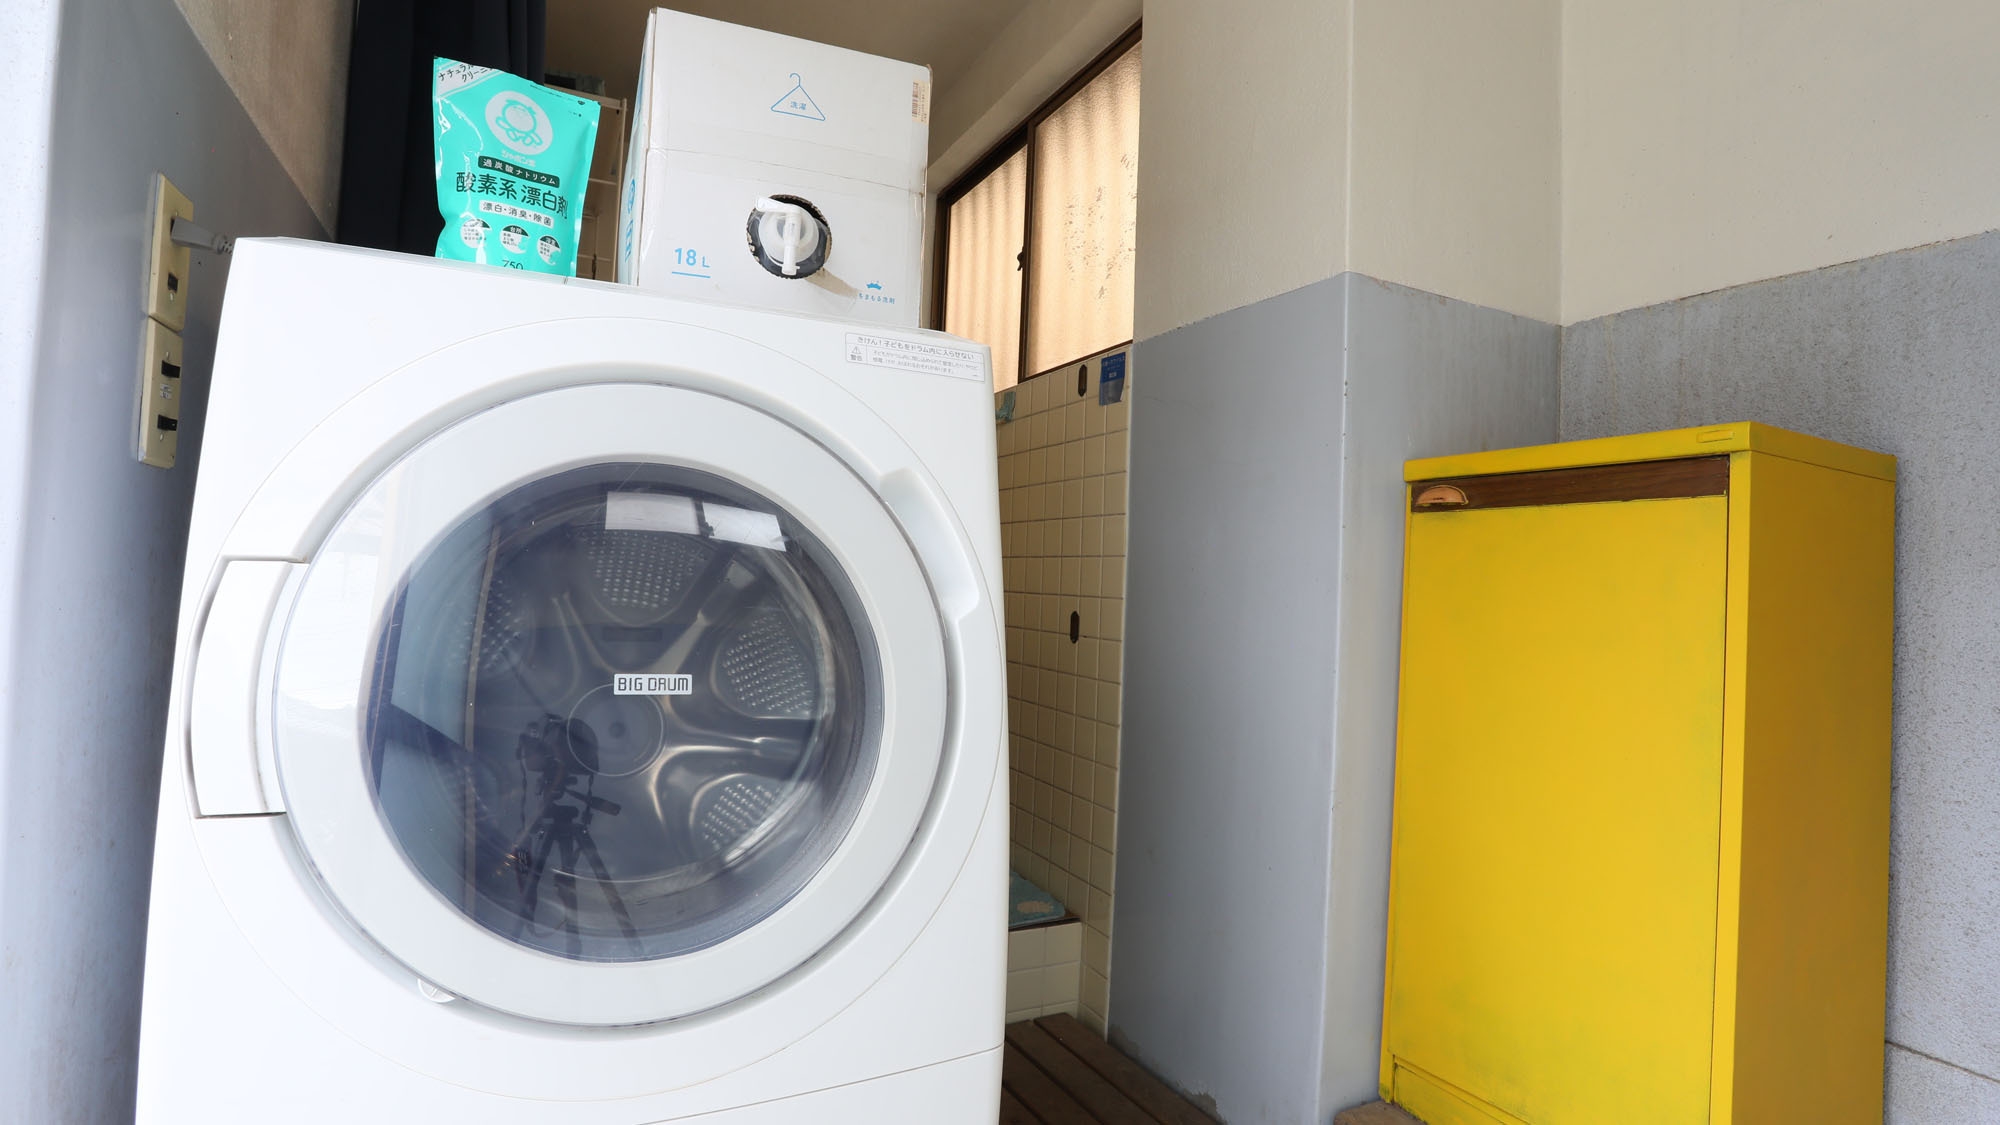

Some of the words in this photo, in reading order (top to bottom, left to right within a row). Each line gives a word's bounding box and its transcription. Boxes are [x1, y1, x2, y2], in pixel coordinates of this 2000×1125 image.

[462, 67, 493, 82] クリーニ
[483, 158, 556, 185] 過炭酸ナトリウム
[456, 171, 569, 220] 酸素系漂白剤
[618, 677, 643, 691] BIG
[647, 677, 689, 691] DRUM
